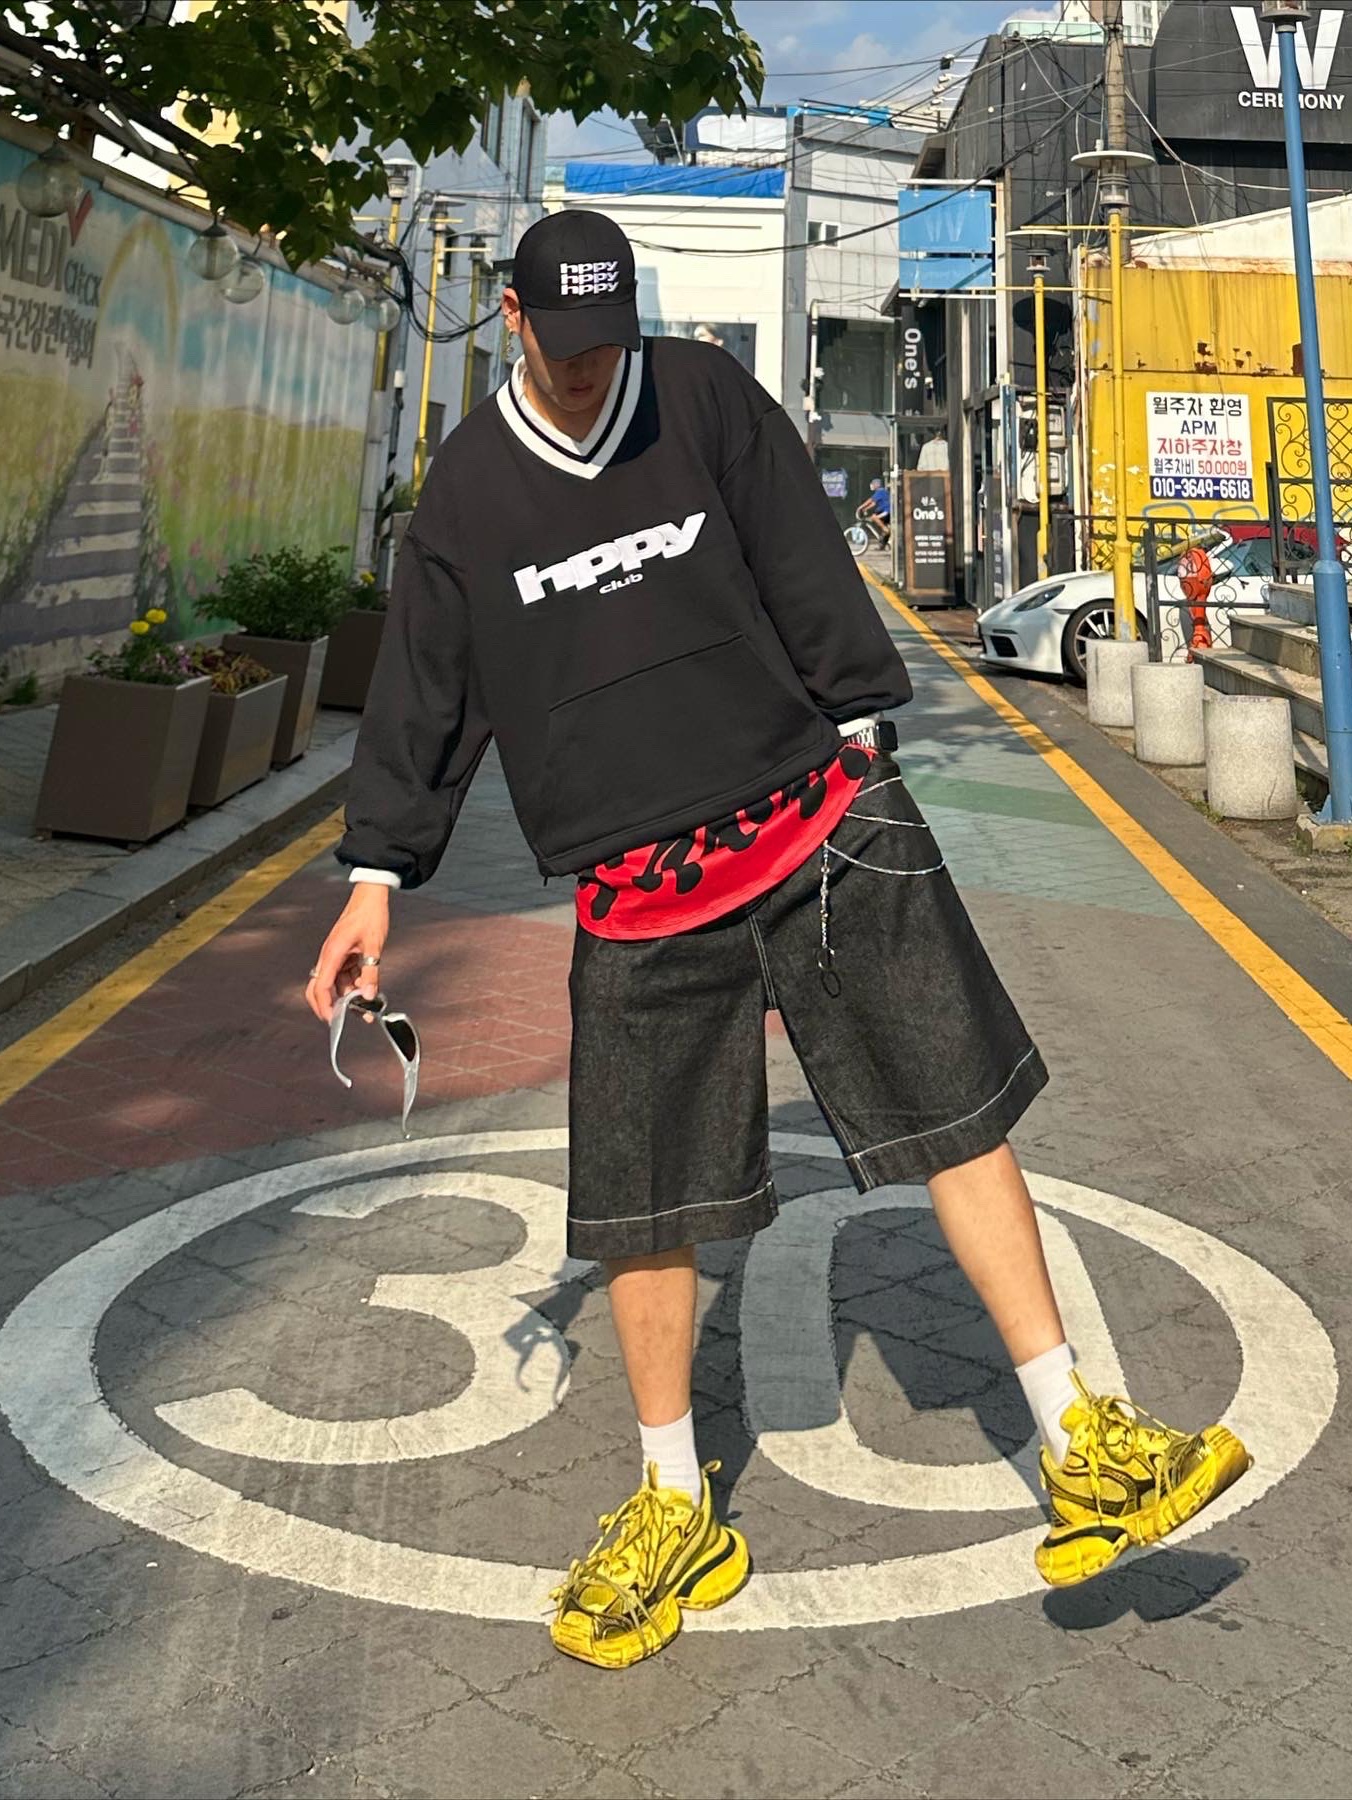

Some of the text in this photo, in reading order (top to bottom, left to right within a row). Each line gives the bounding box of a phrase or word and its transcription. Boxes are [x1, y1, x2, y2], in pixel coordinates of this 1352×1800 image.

[560, 260, 619, 275] hppy
[560, 270, 620, 285] hppy
[560, 281, 620, 296] hppy
[904, 328, 922, 390] One's
[1152, 396, 1242, 417] 월주차 환영
[1180, 419, 1217, 435] APM
[1152, 477, 1251, 499] 010-3649-6618
[913, 506, 945, 521] One's
[513, 511, 707, 606] hppy
[599, 572, 645, 595] club
[154, 1171, 1136, 1511] 30
